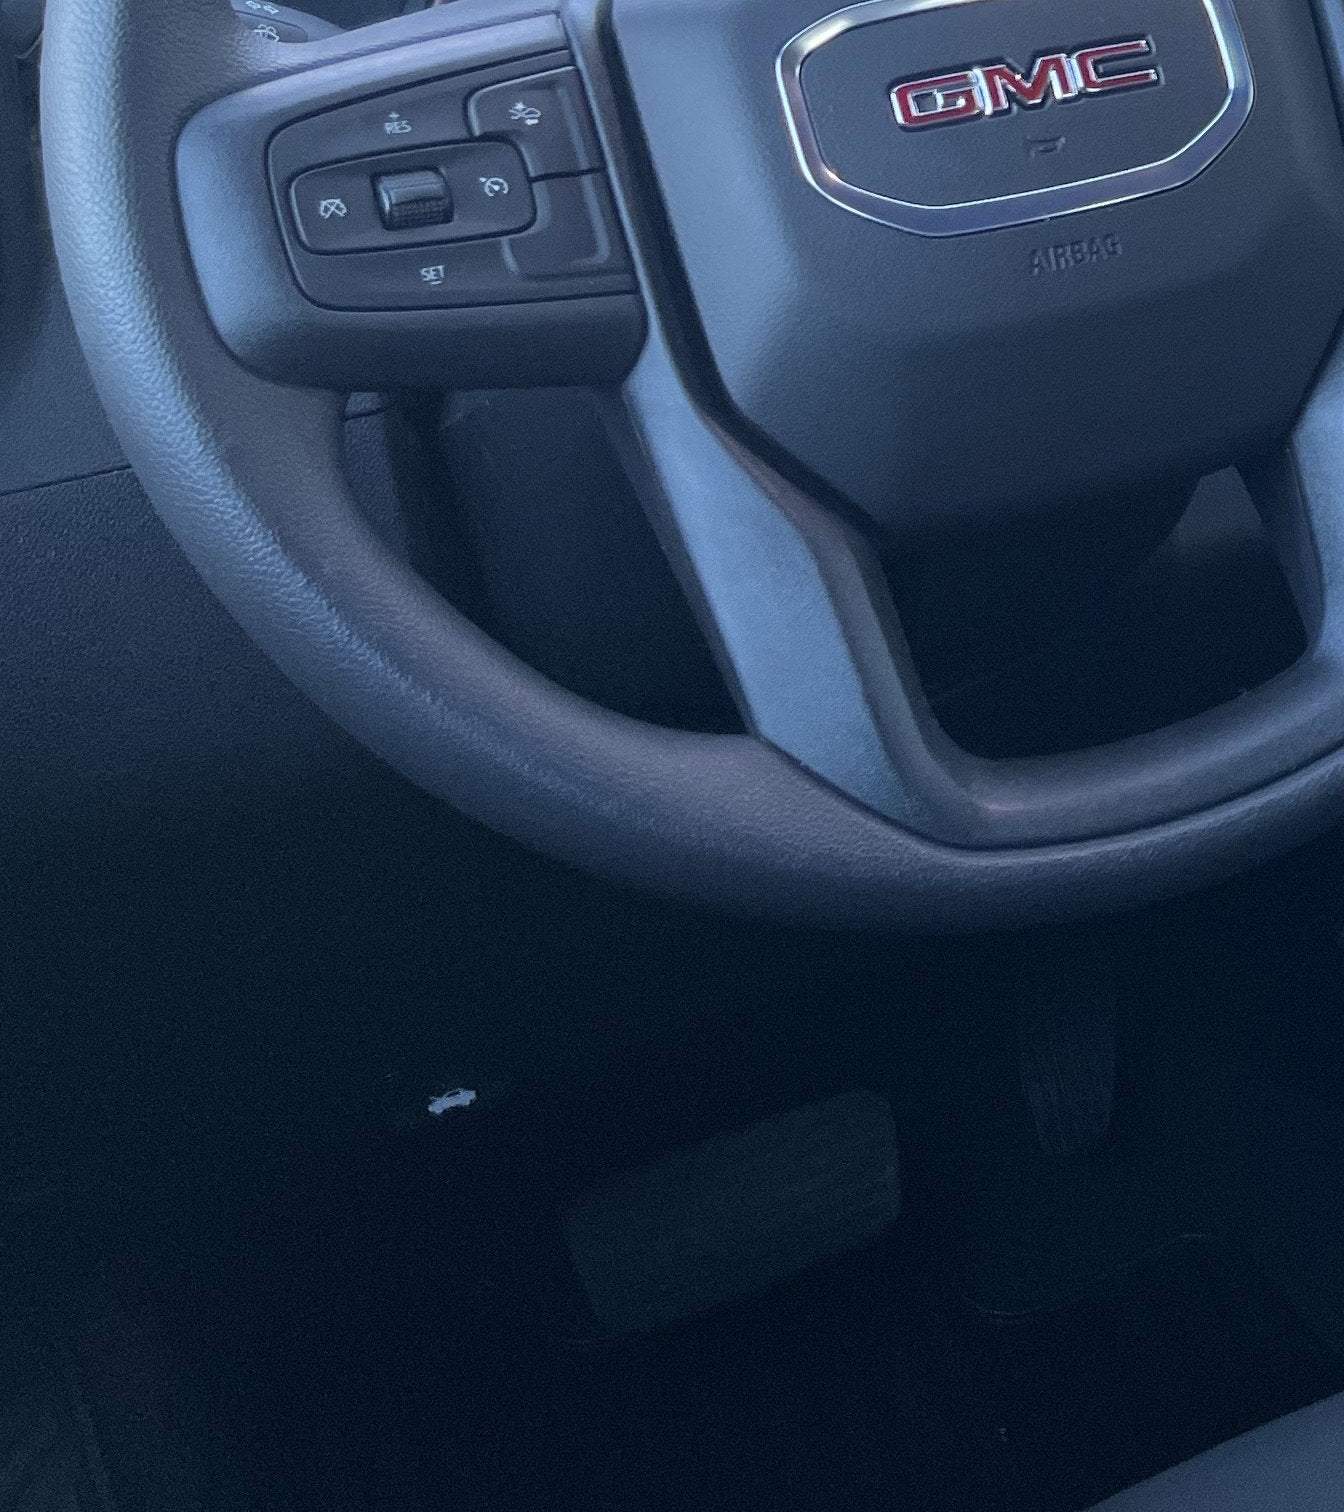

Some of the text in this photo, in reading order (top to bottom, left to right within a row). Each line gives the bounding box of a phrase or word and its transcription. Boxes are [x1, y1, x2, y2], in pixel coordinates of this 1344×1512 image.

[889, 39, 1159, 127] GMC
[384, 118, 412, 135] RES
[1030, 234, 1124, 276] AIRBAG
[420, 265, 447, 282] SET
